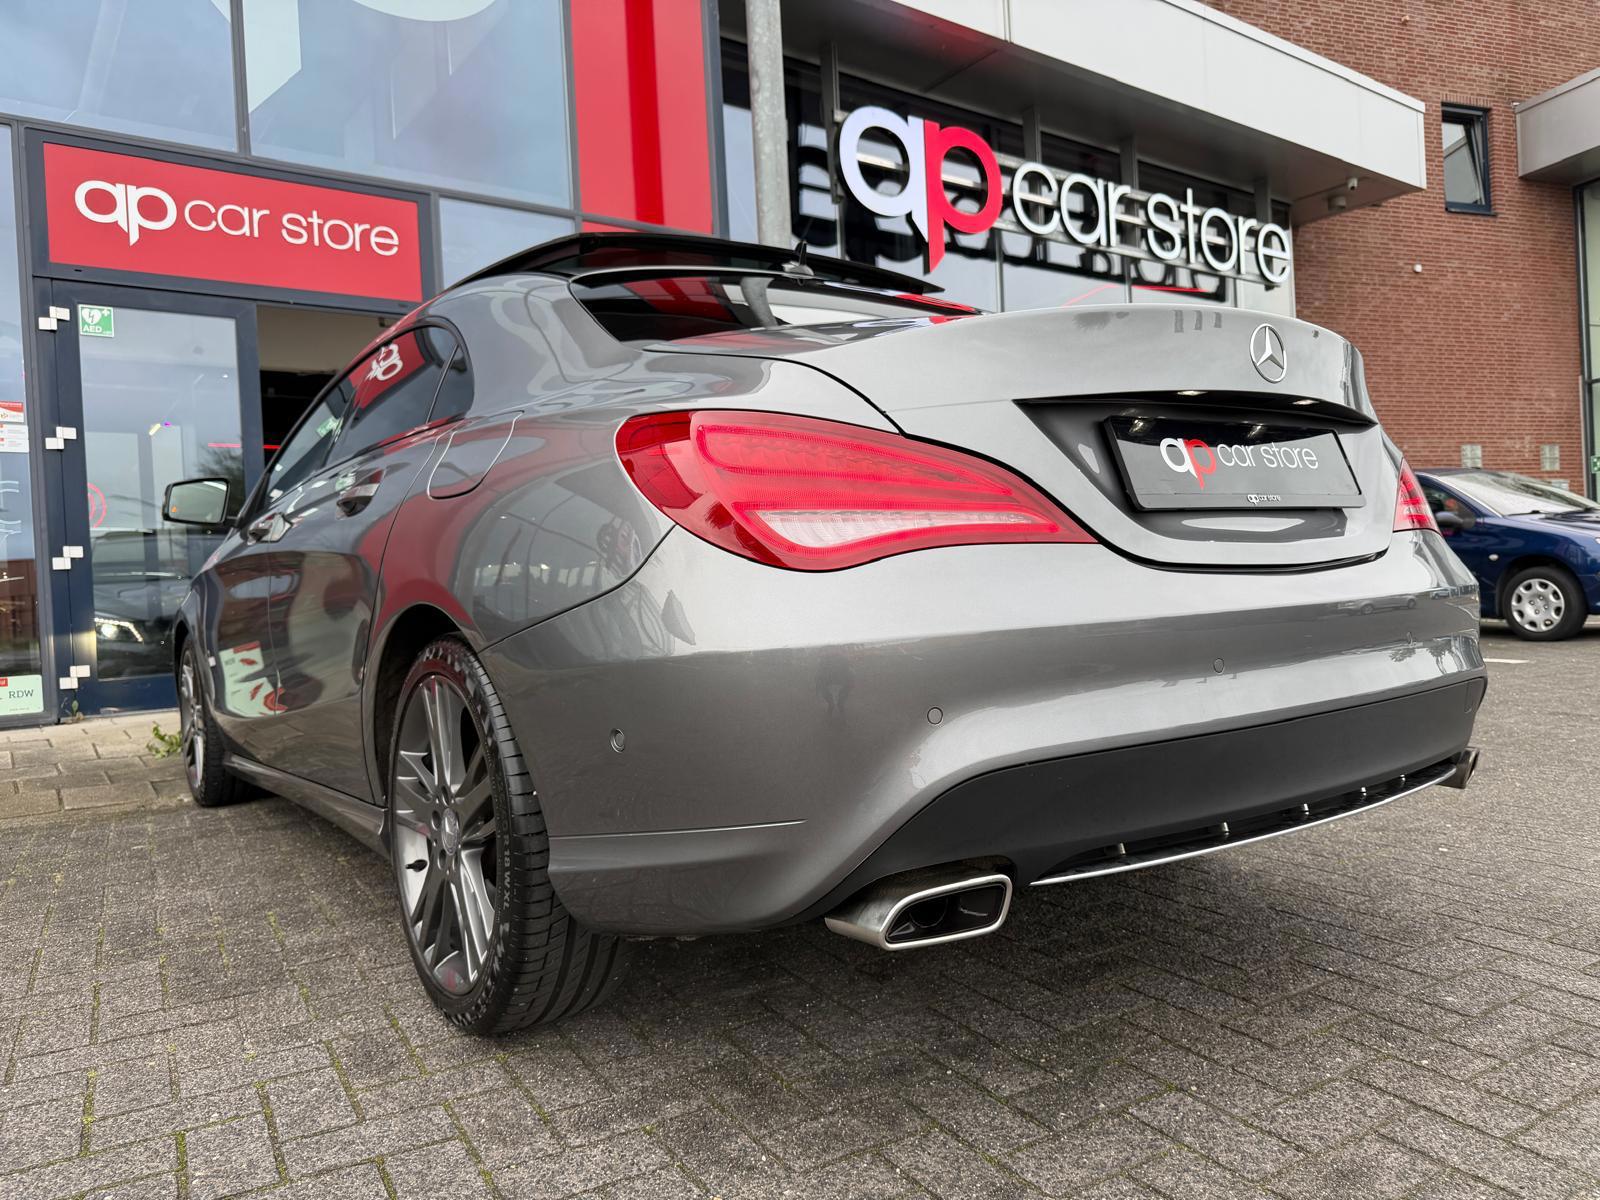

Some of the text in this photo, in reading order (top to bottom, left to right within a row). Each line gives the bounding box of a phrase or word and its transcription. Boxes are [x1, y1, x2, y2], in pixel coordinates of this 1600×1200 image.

[184, 199, 270, 238] car
[281, 209, 400, 257] store
[1011, 161, 1132, 248] car
[1145, 186, 1291, 284] store
[82, 323, 103, 333] AED
[1217, 444, 1260, 468] car
[1261, 443, 1318, 470] store
[8, 689, 34, 699] RDW
